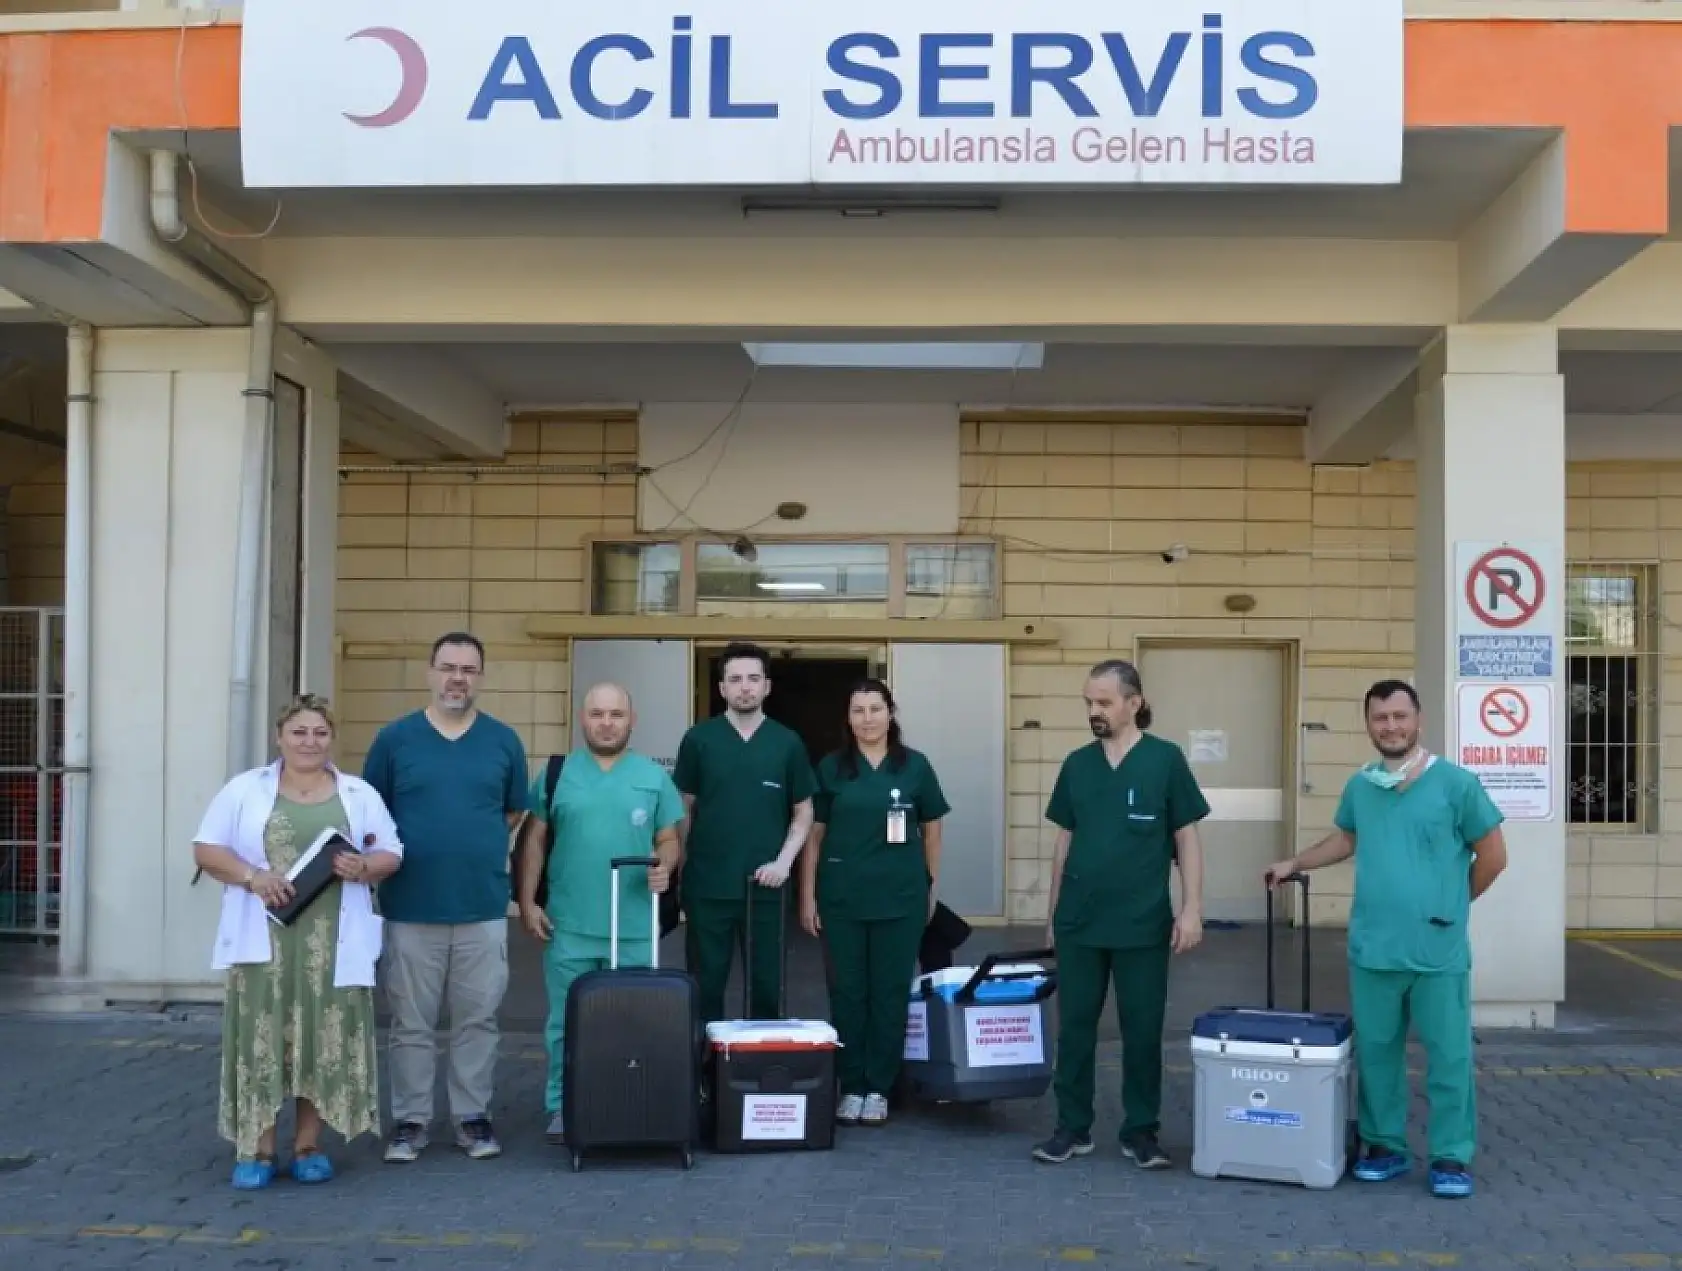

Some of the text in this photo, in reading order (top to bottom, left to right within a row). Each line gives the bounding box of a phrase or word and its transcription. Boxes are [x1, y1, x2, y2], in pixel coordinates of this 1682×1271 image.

[468, 13, 1319, 120] ACİL SERVİS
[828, 126, 1315, 166] Ambulansla Gelen Hasta
[1461, 744, 1548, 768] SİGARA İÇİLMEZ
